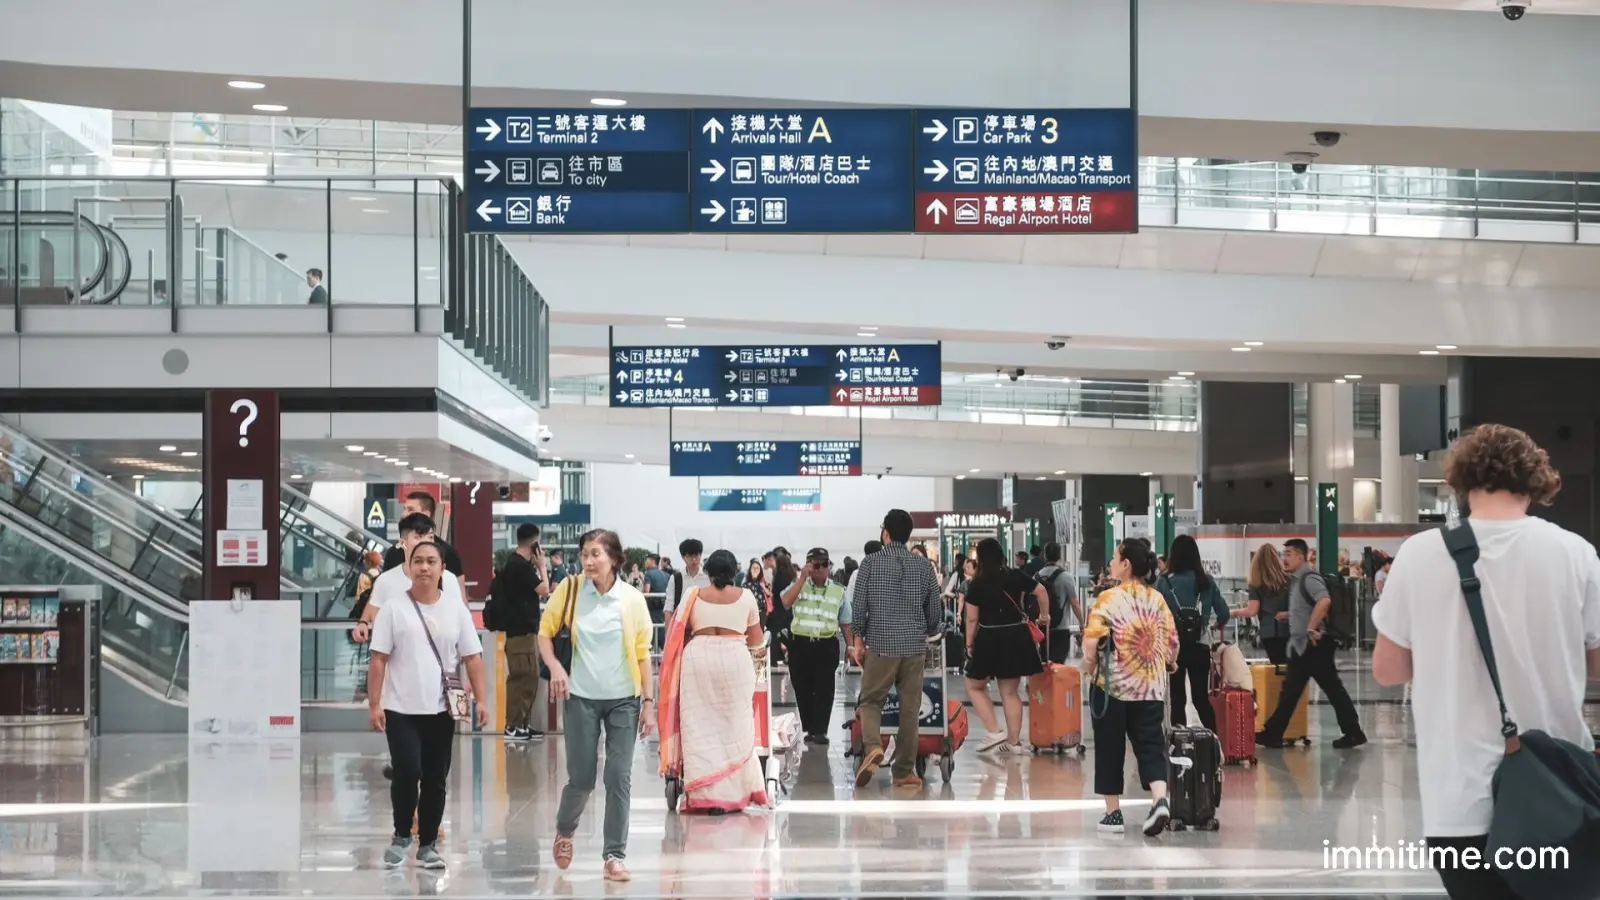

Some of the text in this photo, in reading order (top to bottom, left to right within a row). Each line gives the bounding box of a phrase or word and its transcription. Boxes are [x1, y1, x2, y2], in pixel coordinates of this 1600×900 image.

[536, 114, 646, 131] 二號客運大樓
[731, 114, 803, 131] 接機大堂
[983, 115, 1036, 131] 停車場
[508, 122, 530, 138] T2
[807, 117, 832, 144] A
[958, 120, 975, 141] P
[1041, 117, 1058, 144] 3
[537, 131, 598, 144] Terminal 2
[731, 131, 801, 144] Arrivals Hall
[983, 132, 1032, 144] Car Park
[568, 155, 624, 172] 往市區
[761, 155, 871, 172] 團隊/酒店巴士
[984, 155, 1114, 172] 往內地/澳門交通
[568, 173, 608, 188] To city
[761, 172, 860, 185] Tour/Hotel Coach
[984, 173, 1131, 187] Mainland/Macao Transport
[536, 194, 572, 212] 銀行
[984, 196, 1092, 213] 富豪機場酒店
[536, 213, 566, 225] Bank
[984, 213, 1092, 227] Regal Airport Hotel
[631, 352, 643, 361] T1
[741, 352, 753, 362] T2
[887, 348, 900, 362] A
[633, 371, 641, 381] P
[656, 376, 670, 384] Park
[673, 369, 684, 384] 4
[770, 376, 790, 385] To city
[881, 395, 902, 403] Airport
[902, 394, 919, 402] Hotel
[704, 443, 712, 452] A
[770, 442, 777, 452] 4
[367, 501, 385, 520] A
